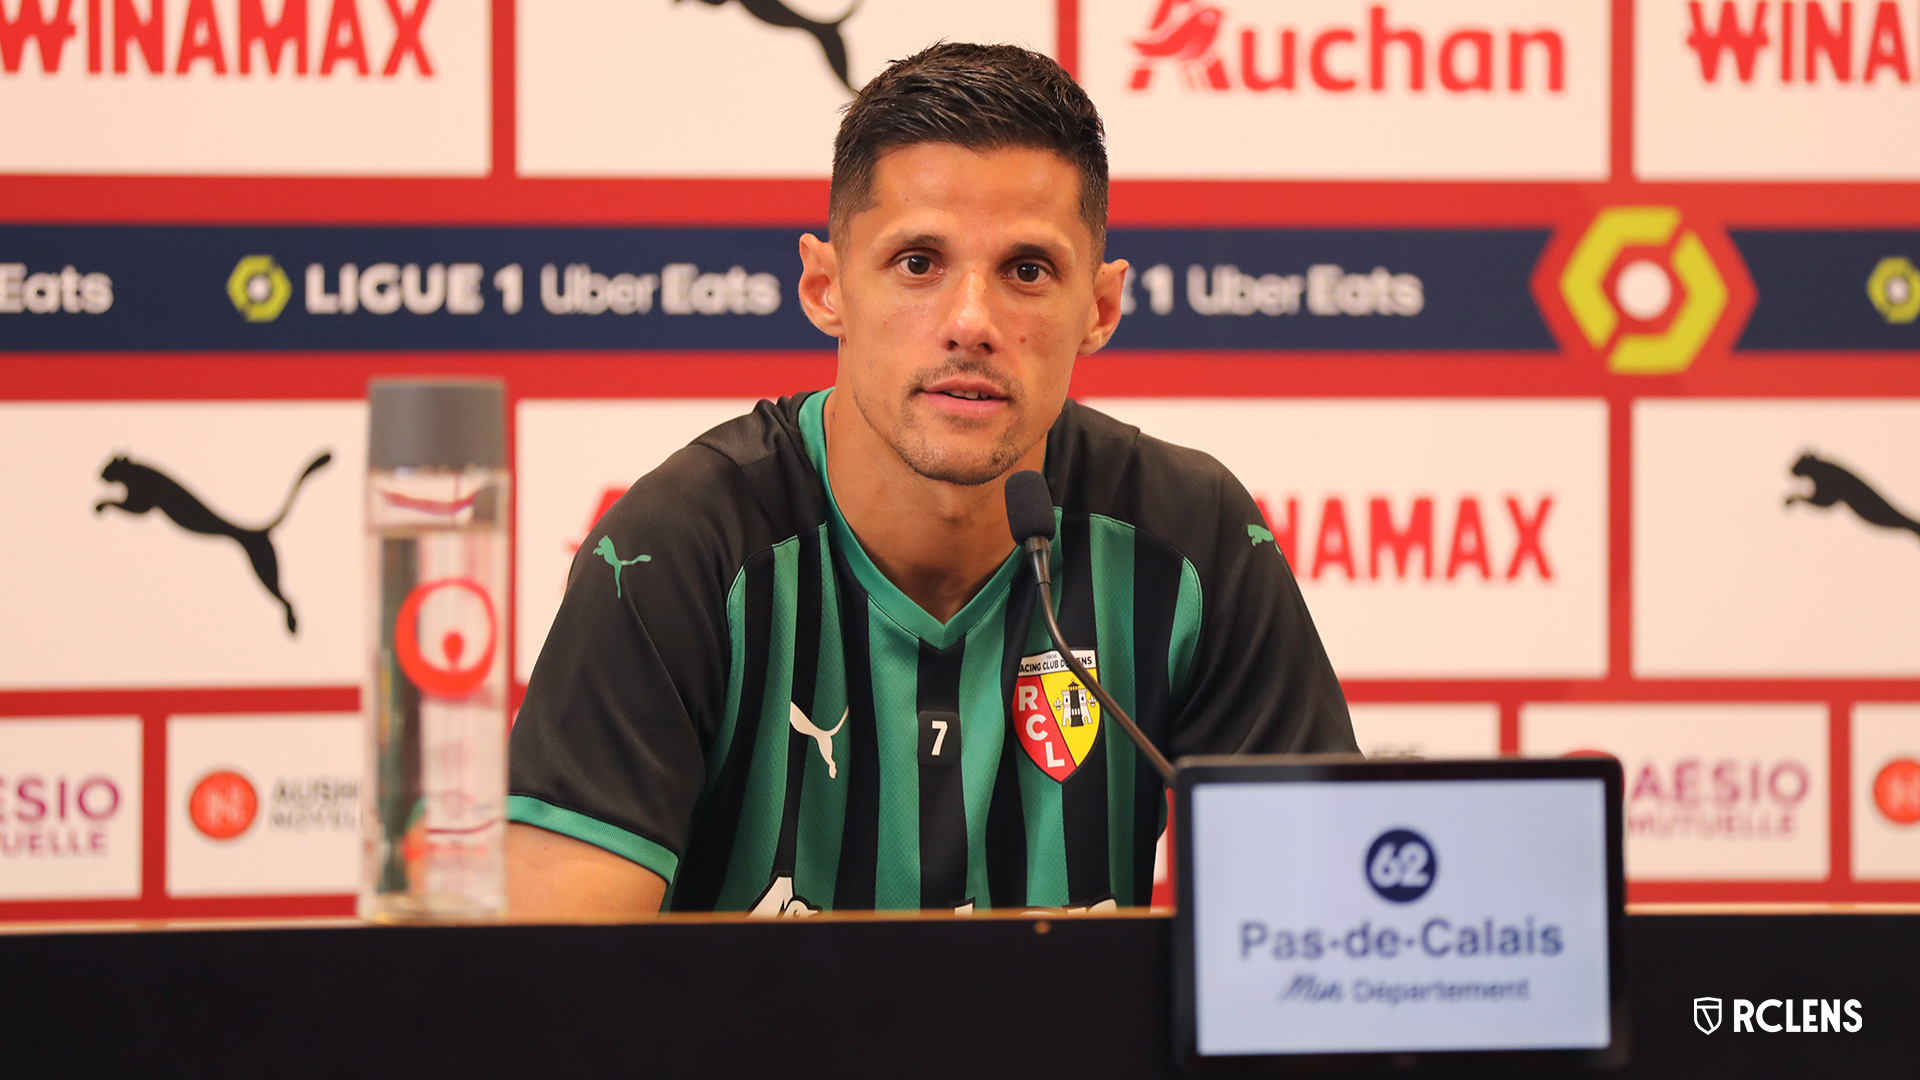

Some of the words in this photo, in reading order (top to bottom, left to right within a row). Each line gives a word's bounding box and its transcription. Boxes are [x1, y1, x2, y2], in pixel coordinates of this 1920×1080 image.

[0, 0, 436, 78] WINAMAX
[1128, 0, 1567, 92] Auchan
[1686, 0, 1920, 84] WINA
[0, 262, 114, 314] Eats
[304, 263, 484, 314] LIGUE
[494, 263, 523, 315] 1
[540, 263, 660, 315] Uber
[661, 263, 782, 315] Eats
[1141, 263, 1174, 316] 1
[1187, 263, 1304, 316] Uber
[1306, 263, 1425, 316] Eats
[1255, 494, 1556, 582] NAMAX
[1019, 663, 1041, 673] ACING
[1042, 659, 1059, 671] CLUB
[931, 720, 948, 756] 7
[0, 775, 120, 822] SIO
[1369, 841, 1432, 889] 62
